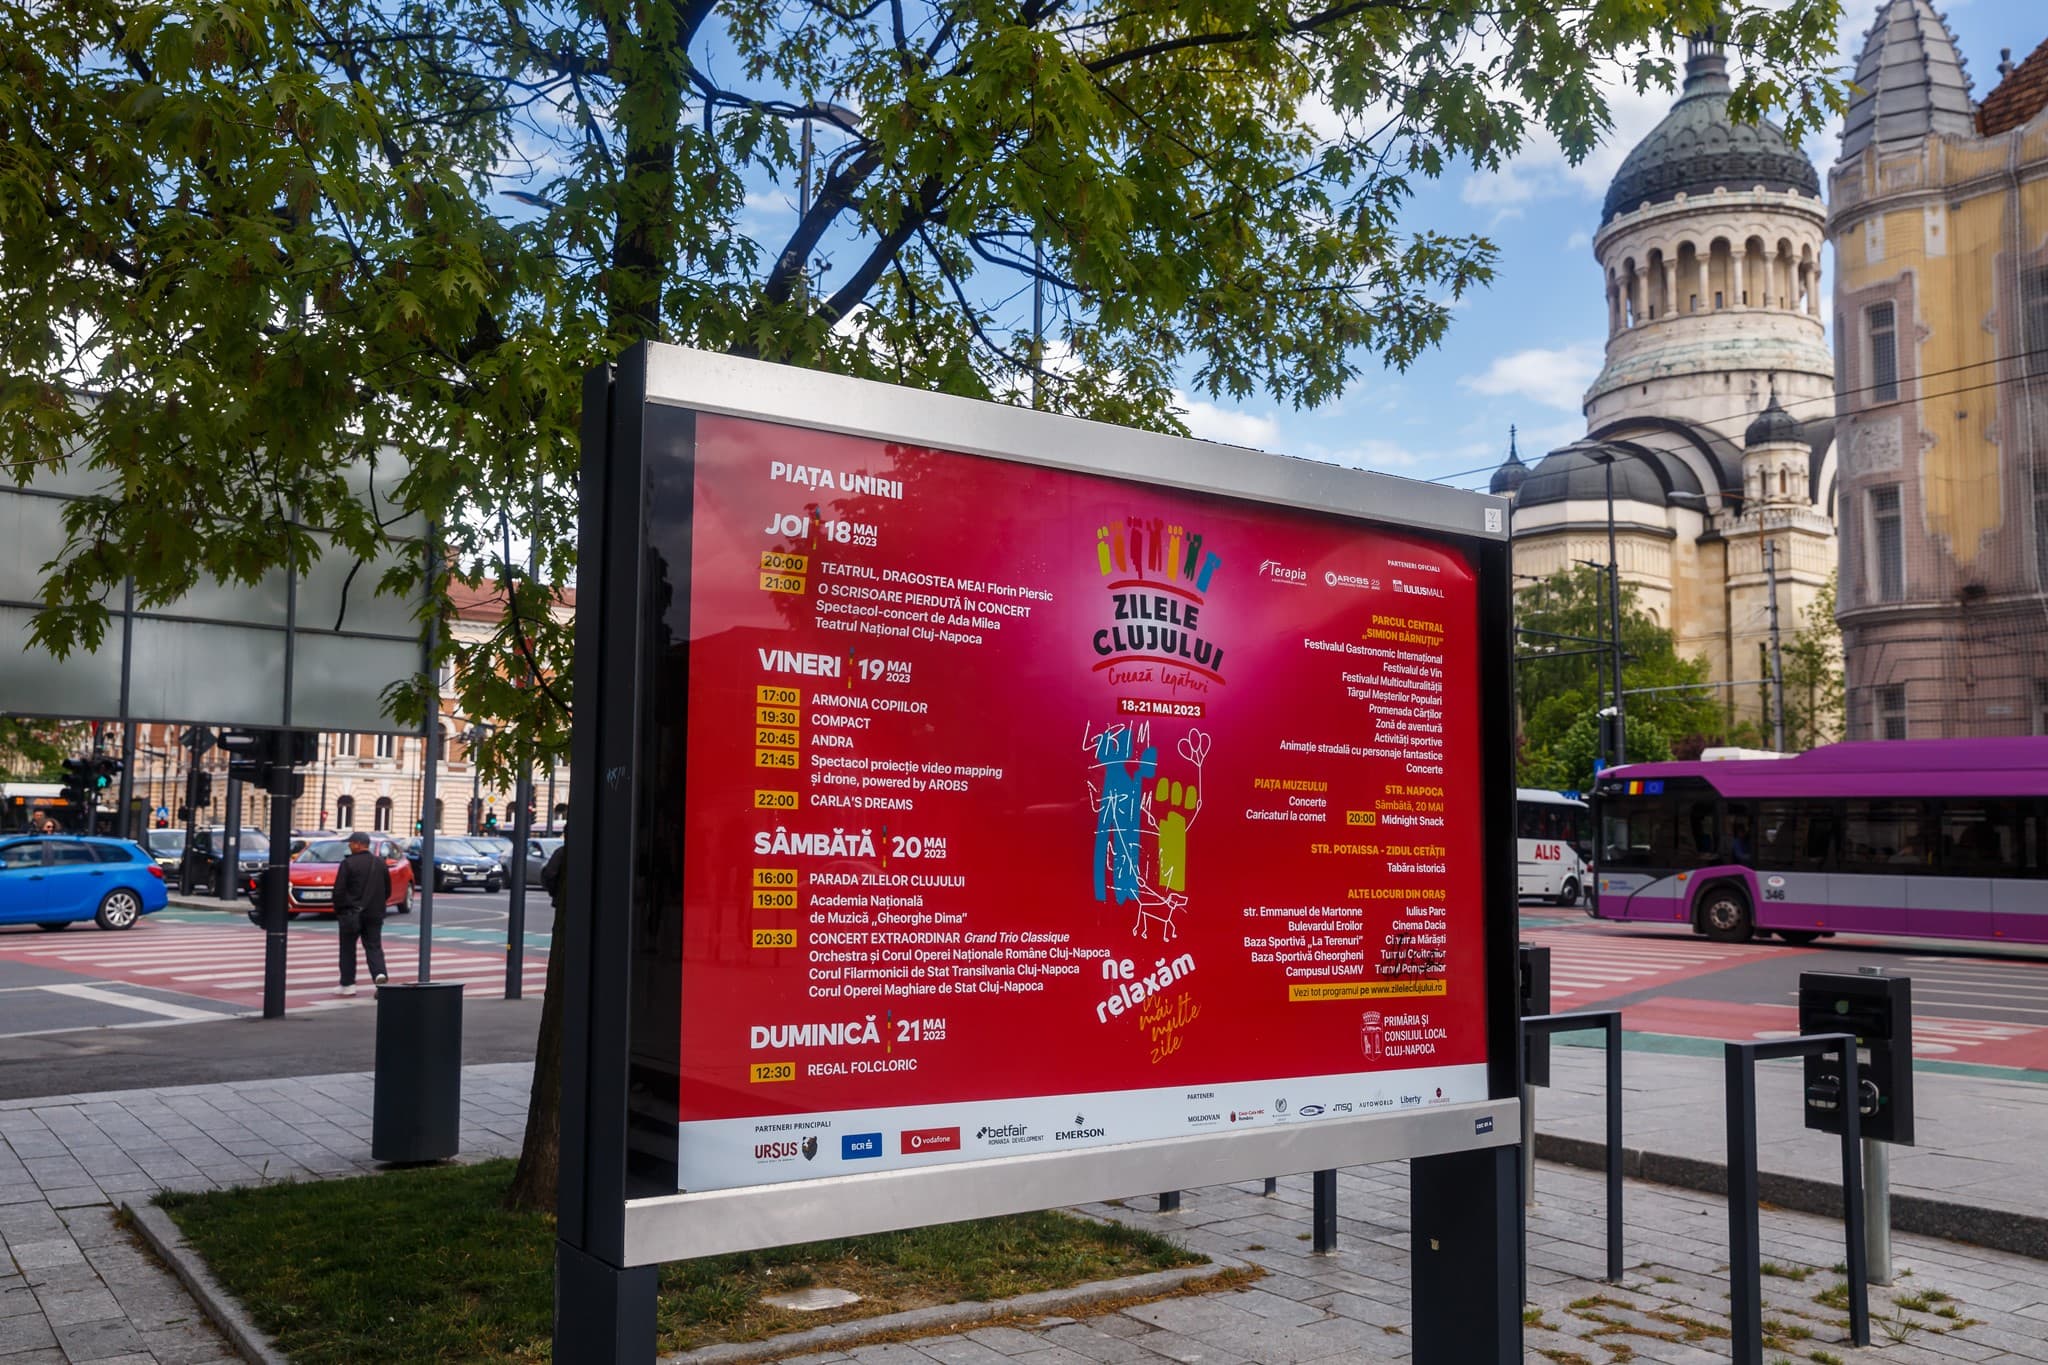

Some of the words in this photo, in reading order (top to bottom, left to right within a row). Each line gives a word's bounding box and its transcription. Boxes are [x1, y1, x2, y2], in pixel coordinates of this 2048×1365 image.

[770, 461, 835, 491] PIAȚA
[839, 471, 902, 499] UNIRII
[765, 513, 809, 539] JOI
[825, 521, 851, 544] 18
[853, 523, 877, 537] MAI
[852, 535, 877, 547] 2023
[763, 555, 803, 571] 20:00
[1268, 561, 1307, 580] Terapia
[765, 575, 801, 592] 21:00
[821, 562, 879, 581] TEATRUL,
[883, 569, 955, 589] DRAGOSTEA
[957, 579, 985, 593] MEA!
[988, 583, 1017, 597] Florin
[1019, 587, 1053, 602] Piersic
[1337, 575, 1369, 585] AROBS
[818, 583, 828, 594] O
[831, 584, 903, 603] SCRISOARE
[905, 592, 962, 610] PIERDUTĂ
[964, 597, 976, 611] ÎN
[978, 601, 1031, 618] CONCERT
[816, 599, 928, 622] Spectacol-concert
[930, 612, 945, 624] de
[947, 614, 970, 627] Ada
[972, 616, 1000, 630] Milea
[1112, 593, 1200, 631] ZILELE
[815, 616, 858, 632] Teatrul
[860, 621, 910, 637] Național
[912, 627, 982, 645] Cluj-Napoca
[1372, 614, 1406, 628] PARCUL
[1407, 619, 1444, 633] CENTRAL
[1093, 625, 1224, 672] CLUJULUI
[758, 649, 841, 678] VINERI
[858, 659, 884, 681] 19
[887, 660, 912, 673] MAI
[1383, 662, 1418, 675] Festivalul
[1419, 666, 1429, 677] de
[1430, 668, 1442, 678] Vin
[886, 672, 911, 684] 2023
[762, 690, 796, 703] 17:00
[812, 693, 869, 709] ARMONIA
[871, 698, 928, 714] COPIILOR
[1121, 700, 1151, 713] 18-21
[1152, 701, 1173, 714] MAI
[1174, 704, 1200, 717] 2023
[1369, 703, 1412, 717] Promenada
[761, 711, 796, 724] 19:30
[811, 714, 871, 729] COMPACT
[1396, 720, 1407, 730] de
[759, 732, 795, 745] 20:45
[811, 734, 854, 748] ANDRA
[1410, 737, 1443, 747] sportive
[761, 753, 795, 766] 21:45
[811, 754, 868, 769] Spectacol
[871, 759, 919, 775] proiecție
[921, 762, 952, 774] video
[954, 765, 1003, 780] mapping
[1406, 763, 1443, 775] Concerte
[811, 772, 821, 786] și
[823, 772, 860, 787] drone,
[862, 777, 911, 788] powered
[913, 777, 926, 792] by
[928, 779, 968, 791] AROBS
[1254, 778, 1281, 792] PIAȚA
[1282, 780, 1327, 792] MUZEULUI
[1385, 784, 1405, 795] STR.
[1406, 786, 1444, 797] NAPOCA
[758, 794, 794, 807] 22:00
[864, 797, 913, 810] DREAMS
[1289, 796, 1327, 807] Concerte
[1348, 813, 1375, 823] 20:00
[1382, 814, 1418, 827] Midnight
[1419, 816, 1444, 826] Snack
[754, 826, 875, 857] SÂMBĂTĂ
[891, 836, 921, 858] 20
[924, 837, 946, 849] MAI
[924, 848, 947, 859] 2023
[1535, 844, 1561, 861] ALIS
[757, 872, 793, 885] 16:00
[810, 873, 859, 885] PARADA
[861, 874, 908, 886] ZILELOR
[911, 875, 965, 887] CLUJULUI
[757, 894, 793, 906] 19:00
[810, 894, 868, 906] Academia
[870, 895, 923, 910] Națională
[1347, 889, 1370, 899] ALTE
[1371, 889, 1404, 899] LOCURI
[1405, 889, 1421, 899] DIN
[1422, 889, 1446, 901] ORAȘ
[1765, 889, 1785, 901] 346
[1243, 907, 1258, 917] str.
[1260, 906, 1307, 917] Emmanuel
[1308, 906, 1320, 916] de
[1322, 906, 1363, 916] Martonne
[1406, 906, 1428, 916] Iulius
[1428, 906, 1446, 916] Parc
[1288, 920, 1335, 931] Bulevardul
[1336, 920, 1363, 931] Eroilor
[1392, 920, 1423, 930] Cinema
[1424, 920, 1446, 930] Dacia
[756, 933, 793, 945] 20:30
[809, 932, 869, 945] CONCERT
[871, 932, 960, 944] EXTRAORDINAR
[964, 932, 997, 943] Grand
[999, 931, 1019, 943] Trio
[1020, 931, 1070, 944] Classique
[1251, 952, 1274, 962] Baza
[1314, 950, 1364, 963] Gheorgheni
[1102, 958, 1135, 980] ne
[1286, 965, 1330, 978] Campusul
[1332, 964, 1364, 975] USAMV
[809, 984, 841, 997] Corul
[843, 983, 882, 999] Operei
[884, 983, 936, 998] Maghiare
[938, 982, 952, 994] de
[954, 982, 977, 993] Stat
[979, 981, 1043, 995] Cluj-Napoca
[1096, 953, 1196, 1024] relaxăm
[897, 1020, 919, 1042] 21
[923, 1018, 946, 1030] MAI
[751, 1014, 880, 1049] DUMINICĂ
[923, 1030, 946, 1041] 2023
[1384, 1029, 1423, 1042] CONSILIUL
[1424, 1028, 1447, 1039] LOCAL
[1151, 1035, 1183, 1064] zile
[1385, 1044, 1435, 1057] CLUJ-NAPOCA
[756, 1066, 791, 1079] 12:30
[808, 1062, 848, 1076] REGAL
[851, 1058, 917, 1073] FOLCLORIC
[1400, 1095, 1421, 1104] Liberty
[755, 1123, 792, 1133] PARTENERI
[794, 1121, 831, 1130] PRINCIPALI
[988, 1124, 1027, 1138] betfair
[922, 1135, 951, 1145] vodafone
[1056, 1128, 1104, 1141] EMERSON
[754, 1142, 798, 1159] URSUS
